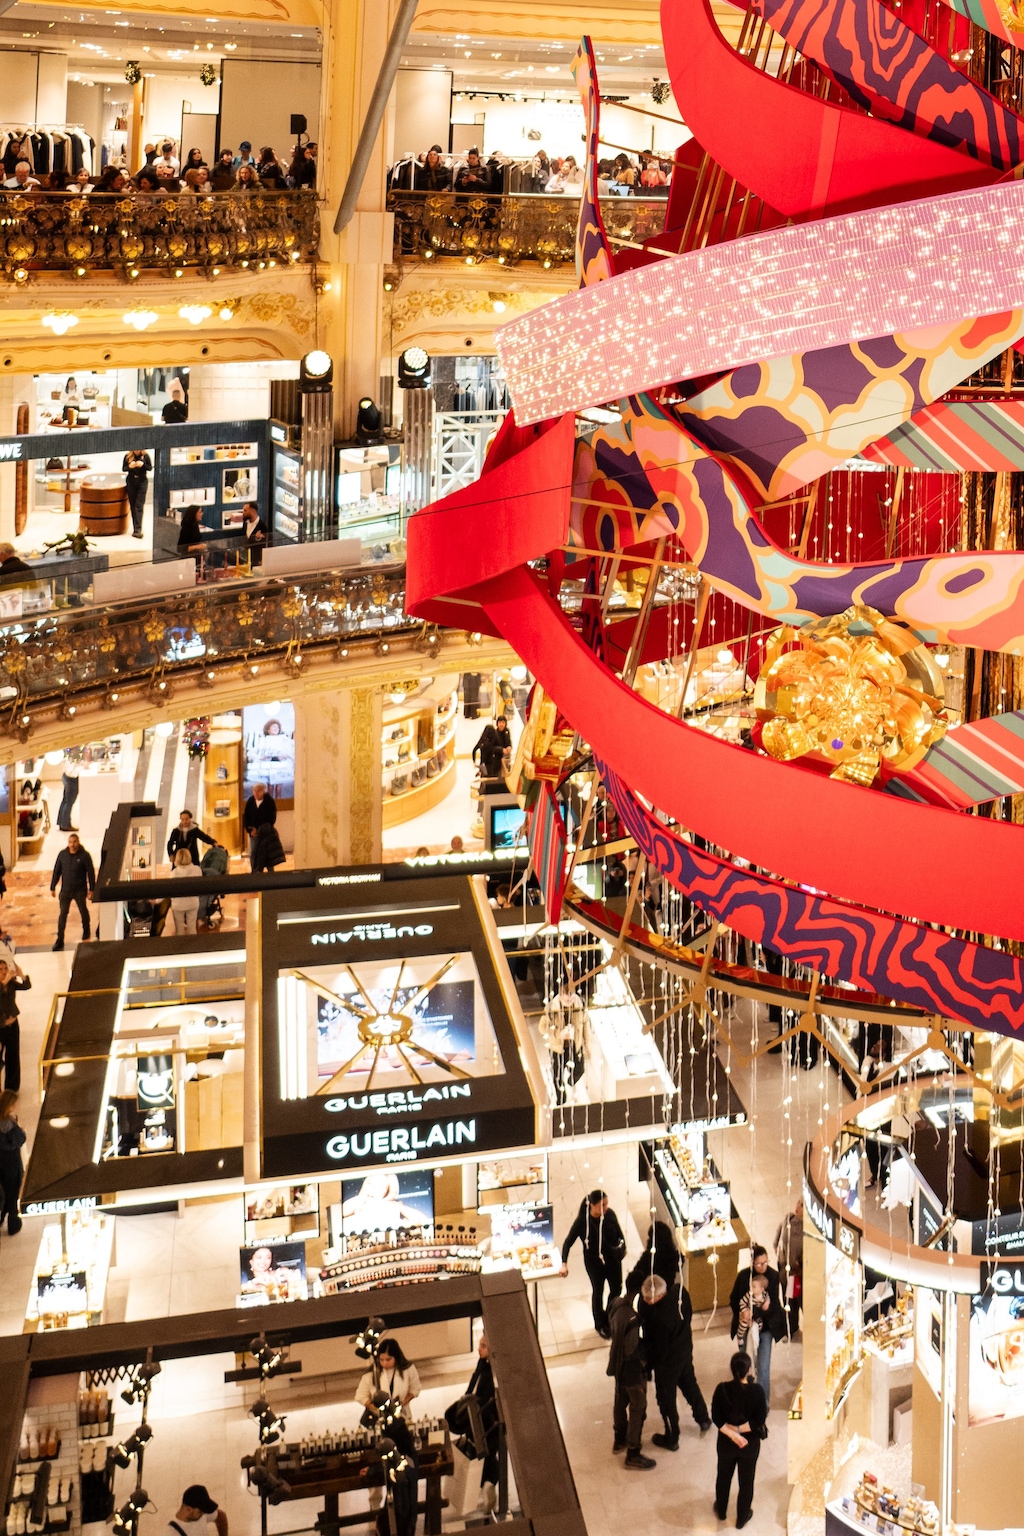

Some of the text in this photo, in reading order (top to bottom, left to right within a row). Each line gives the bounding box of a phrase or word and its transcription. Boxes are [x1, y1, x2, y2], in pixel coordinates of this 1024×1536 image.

[324, 1083, 472, 1112] GUERLAIN
[326, 1119, 477, 1159] GUERLAIN
[26, 1197, 96, 1214] GUERLAIN
[985, 1232, 1019, 1245] CONTEUR
